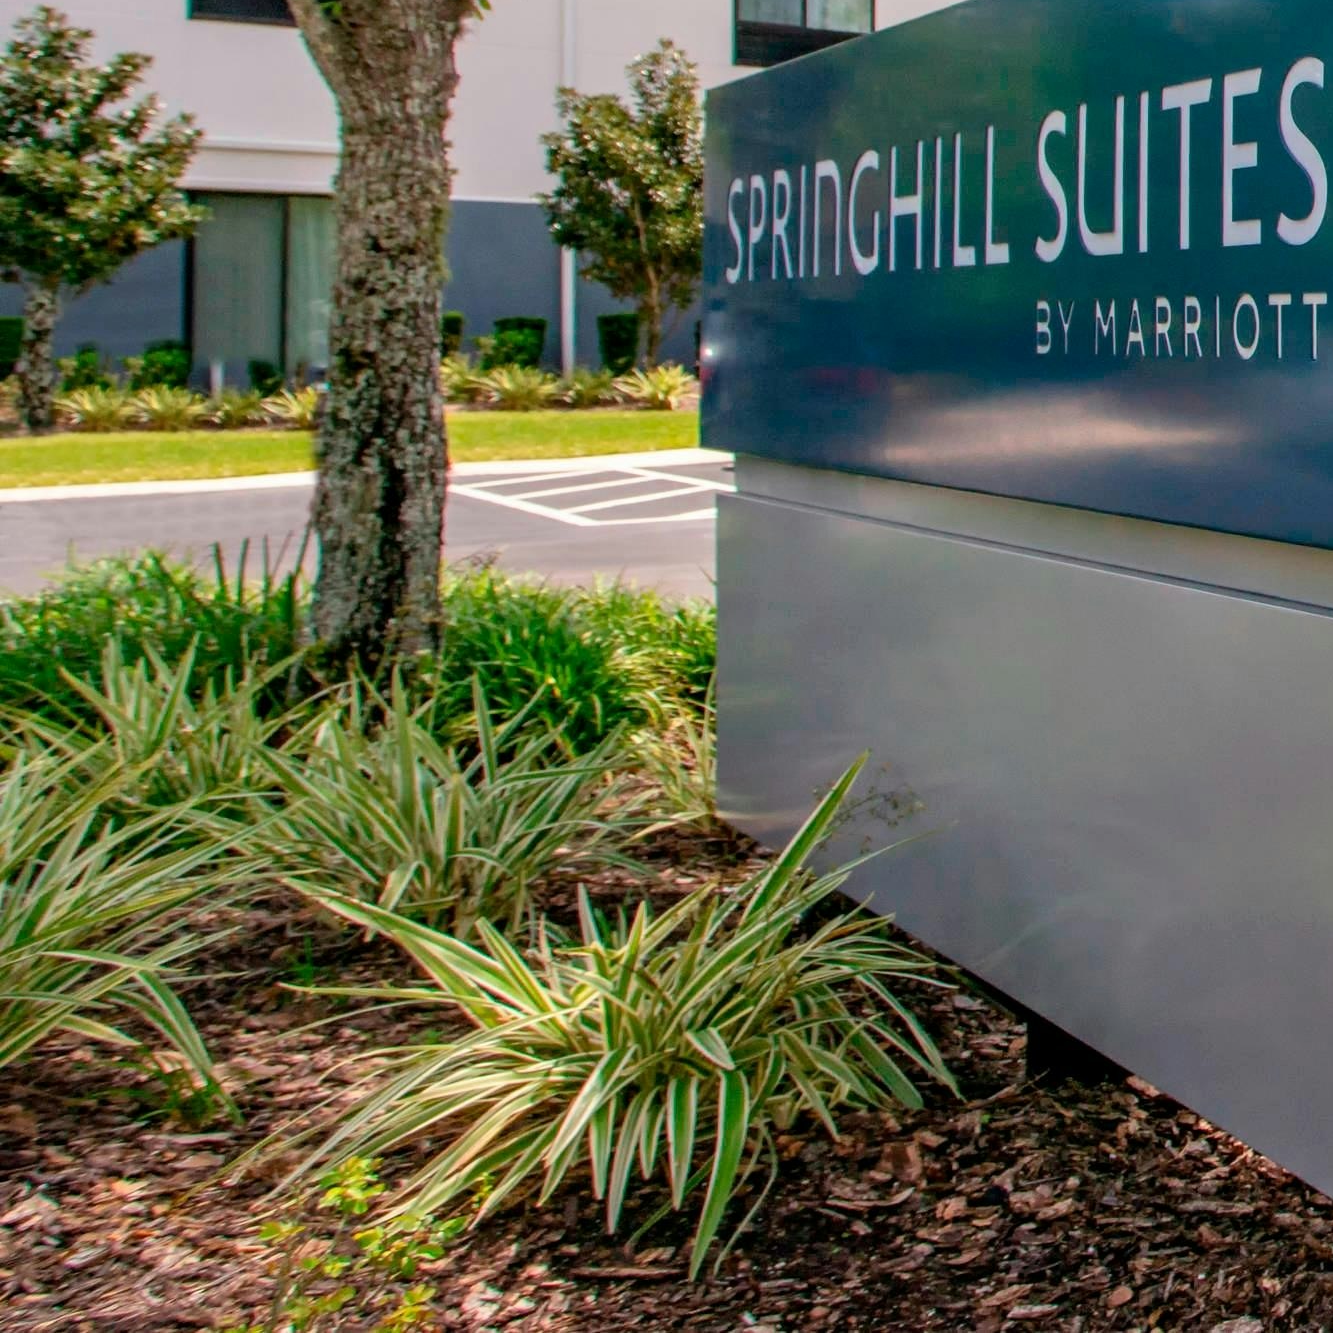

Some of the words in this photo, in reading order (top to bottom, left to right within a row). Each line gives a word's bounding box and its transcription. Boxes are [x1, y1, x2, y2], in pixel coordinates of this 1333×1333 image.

[725, 124, 1010, 284] SPRINGHILL
[1034, 56, 1328, 263] SUITES
[1035, 299, 1075, 355] BY
[1094, 292, 1328, 361] MARRIOTT
